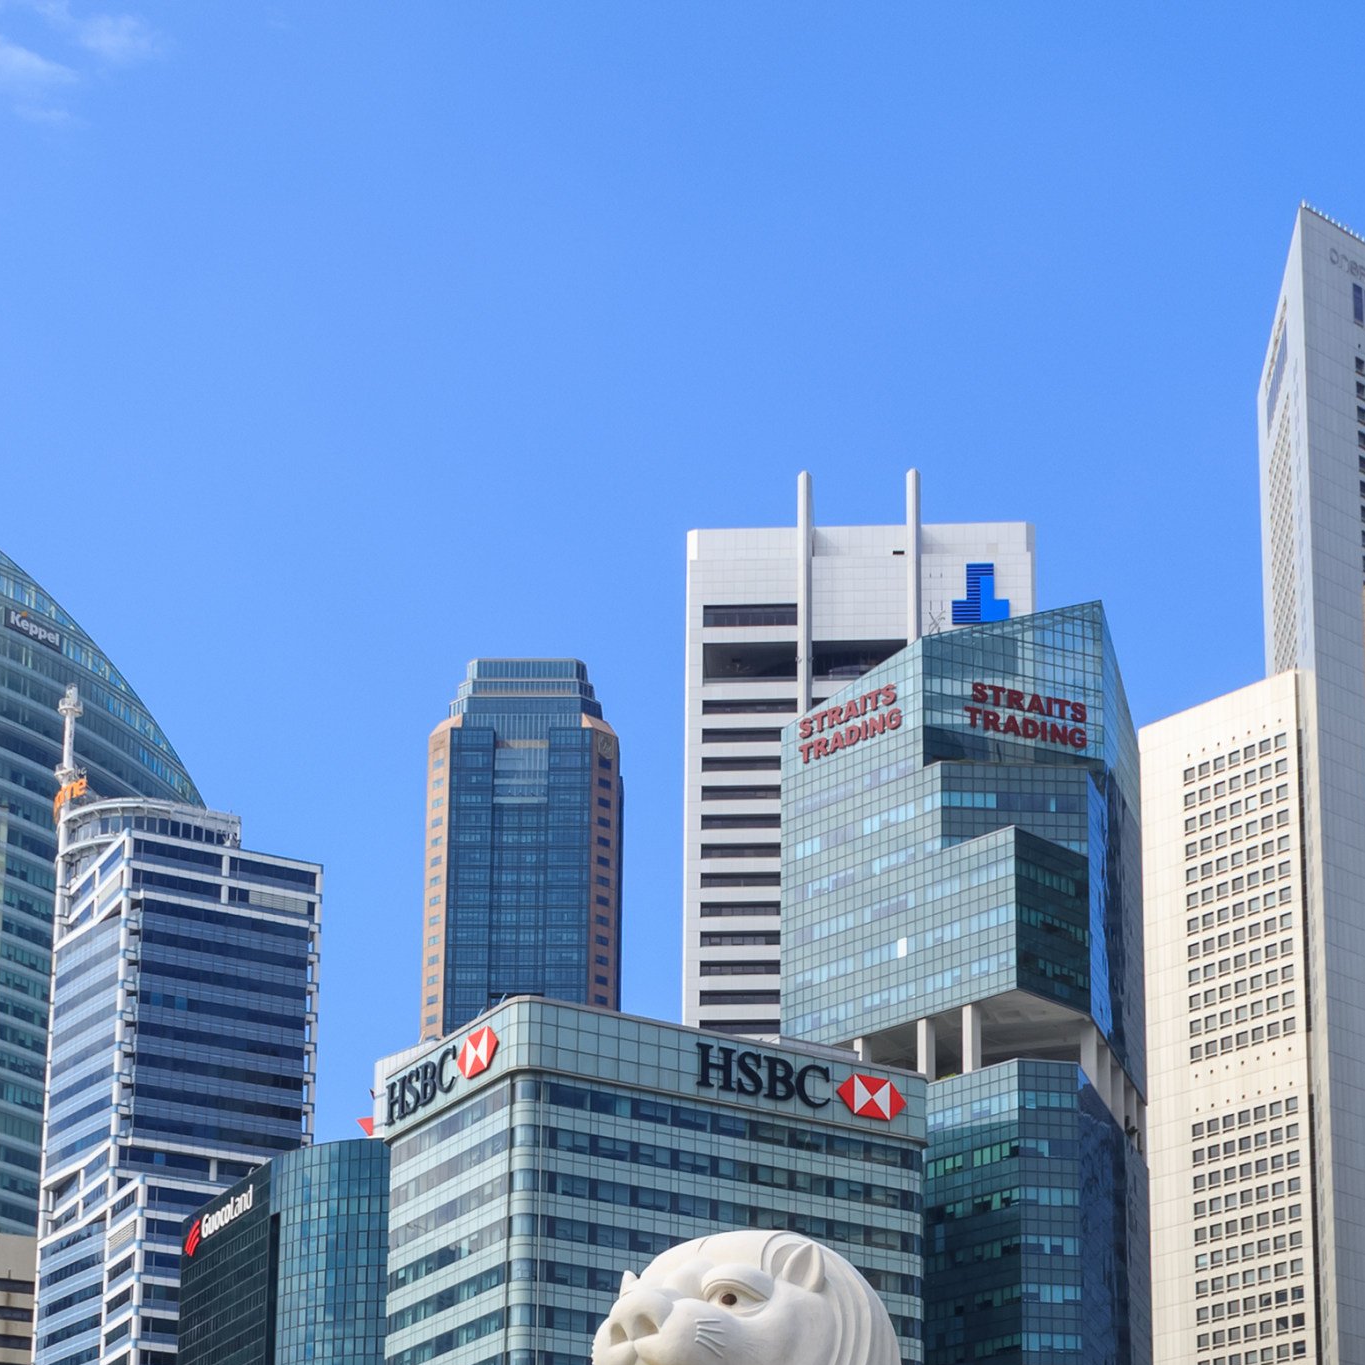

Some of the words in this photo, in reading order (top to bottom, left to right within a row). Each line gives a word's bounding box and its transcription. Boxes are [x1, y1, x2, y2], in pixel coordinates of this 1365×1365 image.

[10, 610, 60, 647] Keppel
[799, 683, 897, 739] STRAITS
[964, 706, 1087, 749] TRADING
[971, 682, 1087, 723] STRAITS
[798, 708, 903, 764] TRADING
[385, 1045, 457, 1127] HSBC
[696, 1042, 831, 1108] HSBC
[201, 1184, 253, 1239] GuocoLand
